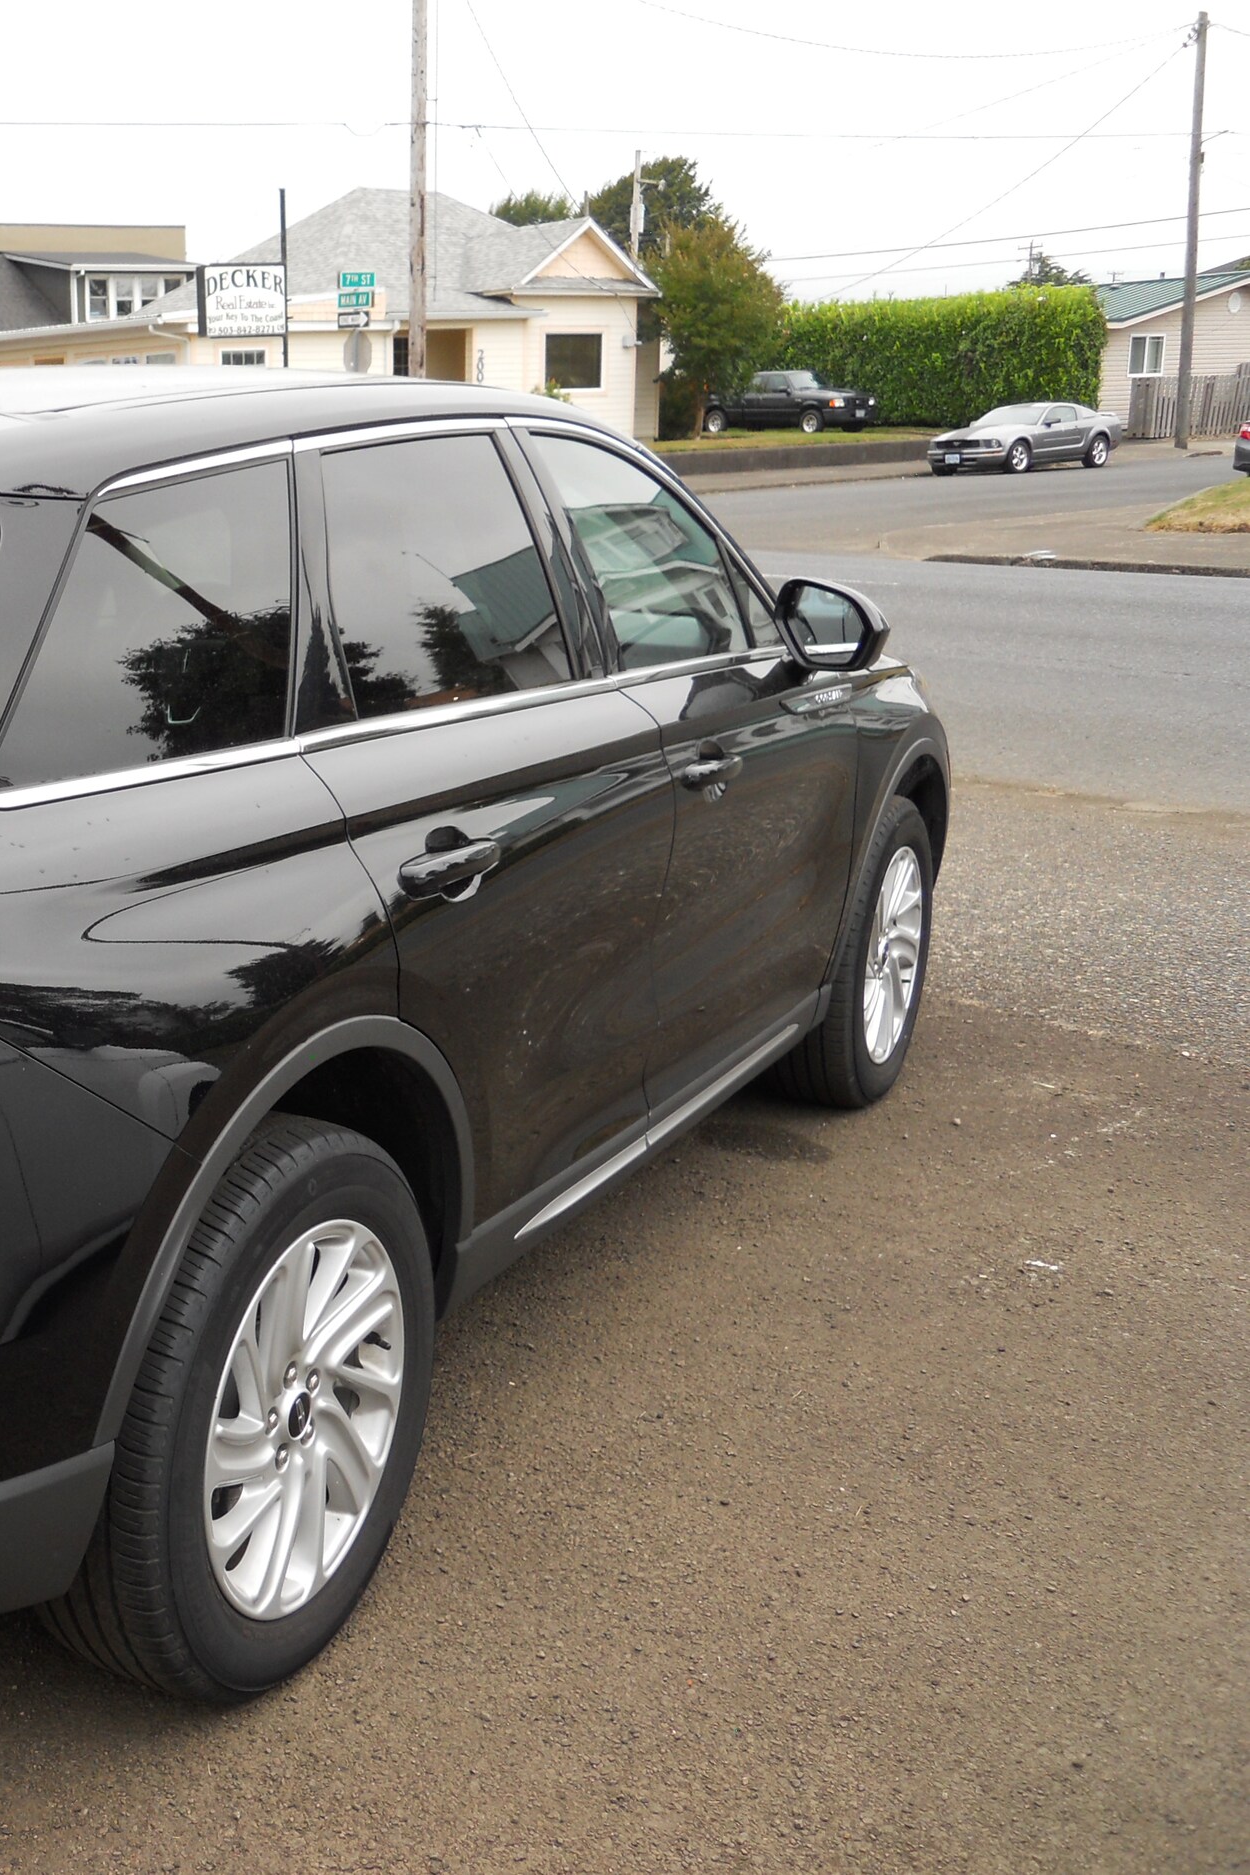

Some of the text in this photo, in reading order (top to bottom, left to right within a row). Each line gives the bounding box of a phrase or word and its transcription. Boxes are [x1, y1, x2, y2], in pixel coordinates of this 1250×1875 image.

[206, 269, 284, 297] DECKER
[345, 274, 371, 285] 7TH ST
[215, 295, 237, 310] Real
[238, 295, 267, 310] Estate
[340, 294, 368, 305] MAIN AV
[226, 312, 238, 322] Key
[240, 313, 249, 321] To
[251, 314, 262, 323] The
